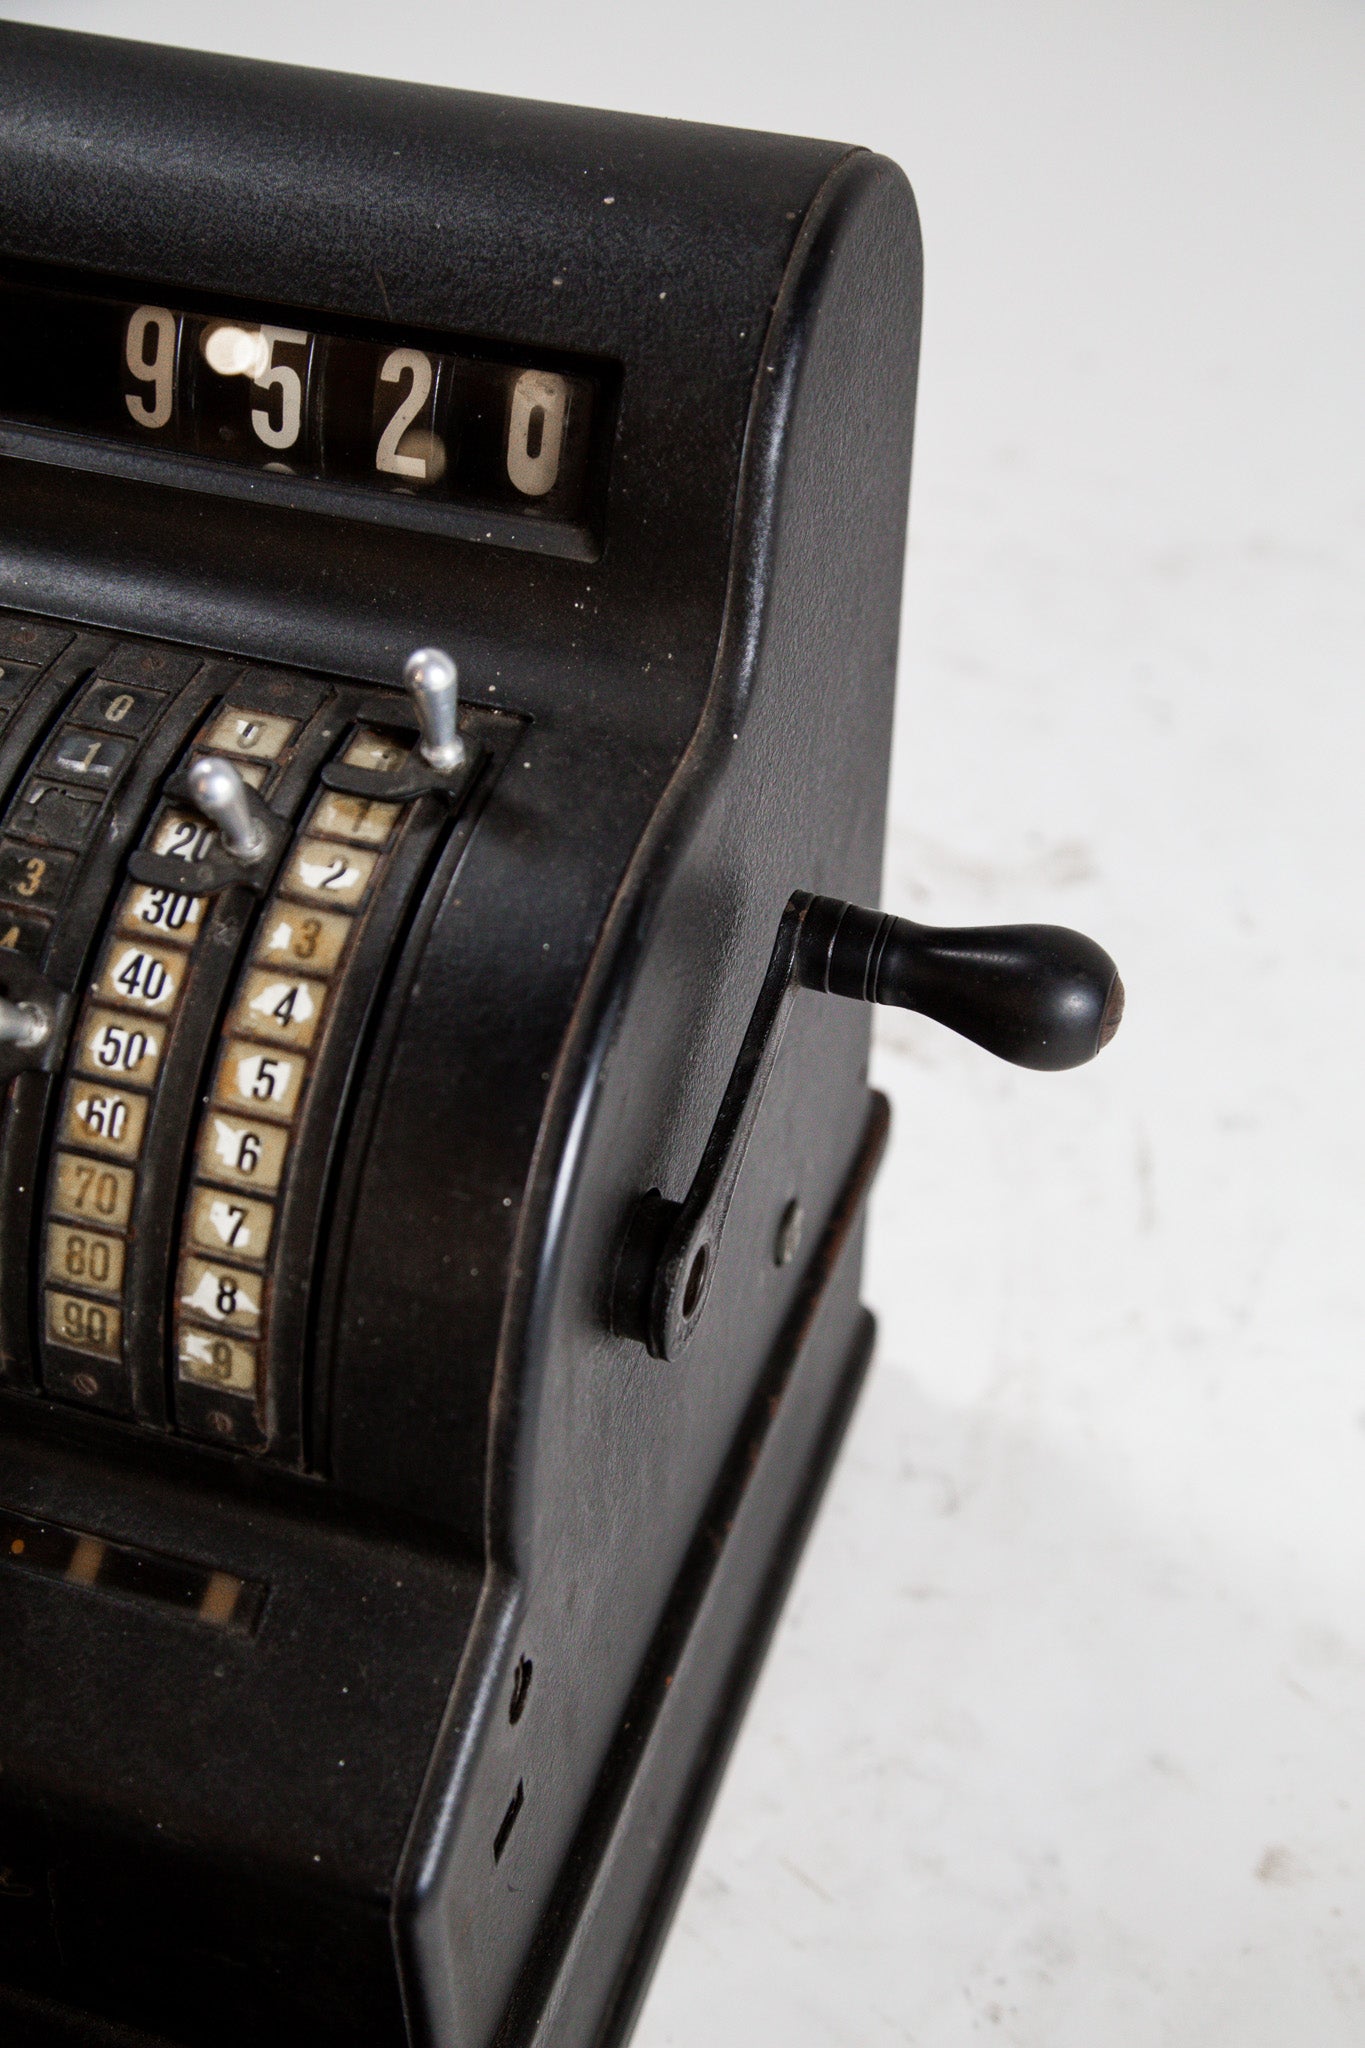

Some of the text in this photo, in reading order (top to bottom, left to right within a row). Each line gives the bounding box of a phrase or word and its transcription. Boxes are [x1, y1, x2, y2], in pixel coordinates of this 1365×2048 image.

[125, 305, 567, 496] 9 5 2 0
[104, 694, 135, 722] 0
[83, 742, 102, 772] 1
[17, 857, 46, 897] 3
[321, 858, 349, 891] 2
[142, 890, 193, 931] 30
[294, 919, 322, 957] 3
[118, 955, 168, 1000] 40
[273, 988, 299, 1026] 4
[99, 1026, 148, 1070] 50
[252, 1061, 279, 1101] 5
[84, 1097, 126, 1139] 60
[237, 1135, 261, 1173] 6
[74, 1167, 117, 1215] 70
[227, 1207, 248, 1246] 7
[65, 1236, 110, 1281] 80
[216, 1277, 238, 1315] 8
[64, 1300, 107, 1344] 90
[211, 1341, 232, 1380] 9
